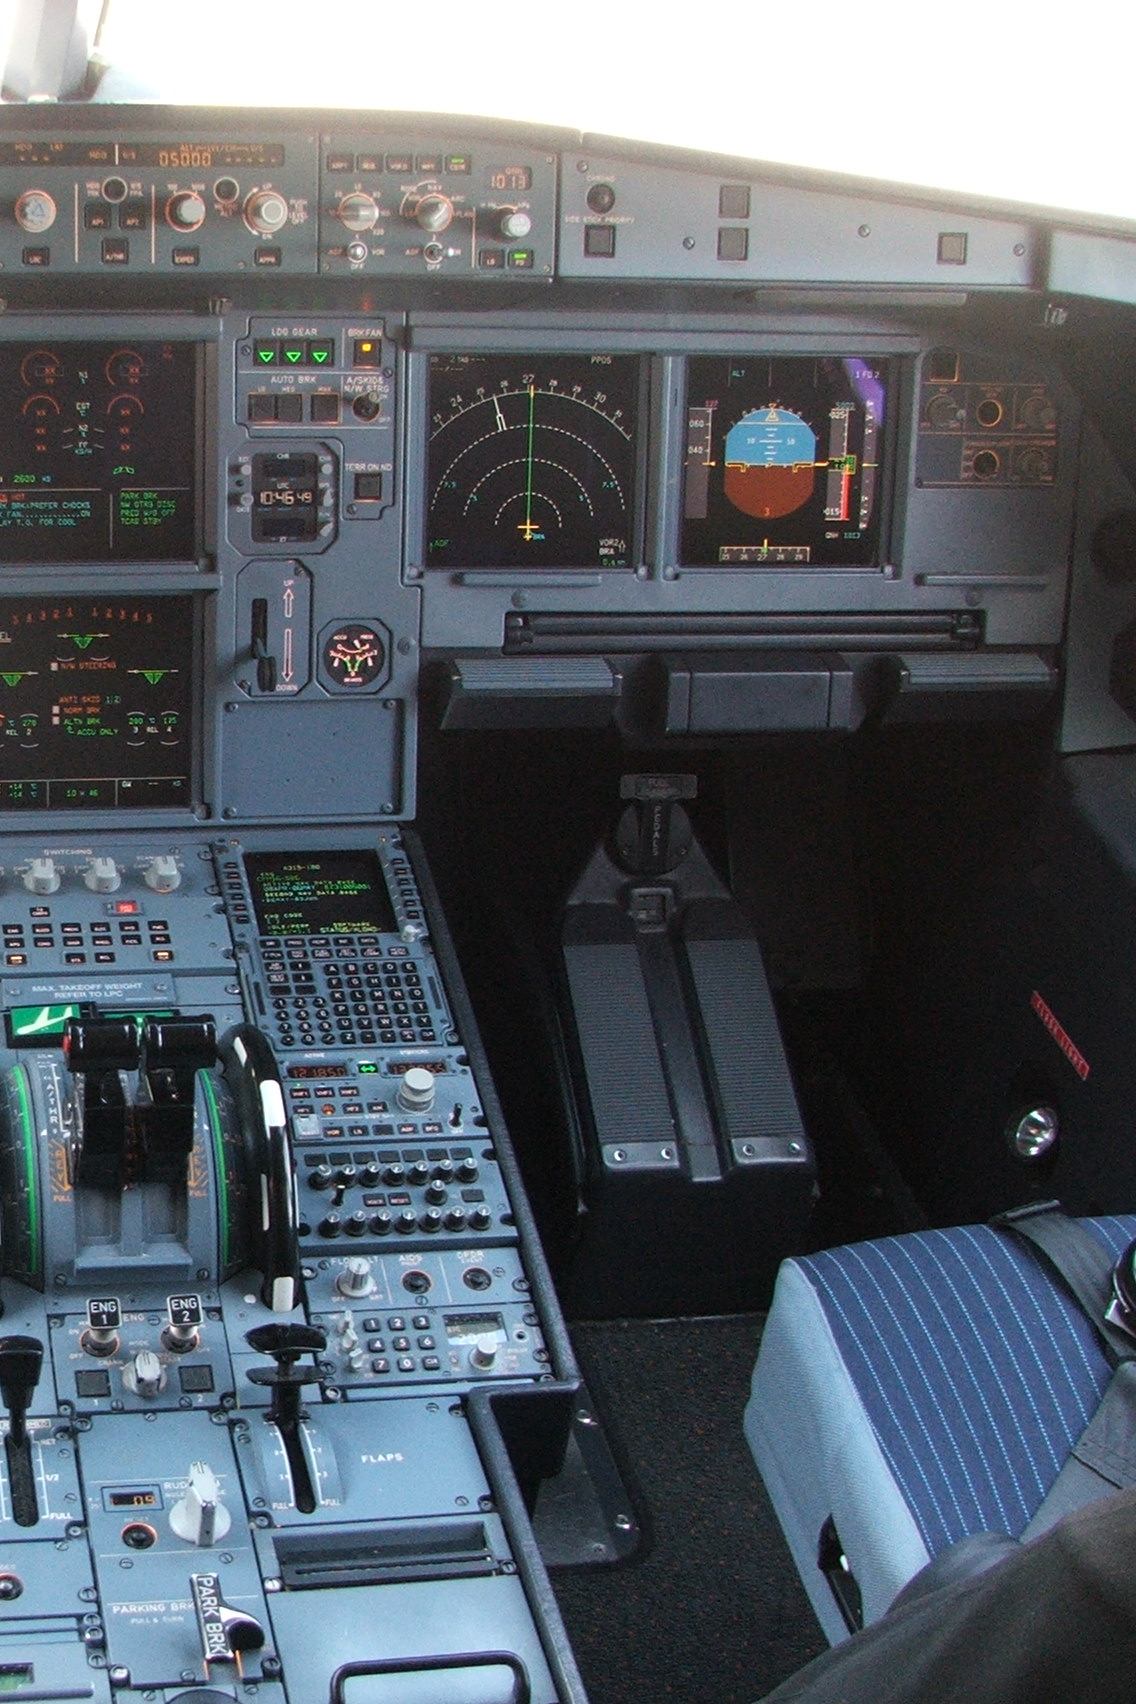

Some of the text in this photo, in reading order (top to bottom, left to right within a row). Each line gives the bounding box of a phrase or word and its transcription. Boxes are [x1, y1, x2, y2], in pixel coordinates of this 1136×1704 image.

[158, 151, 212, 167] 05000
[491, 176, 526, 190] 1013
[522, 374, 535, 384] 27
[592, 394, 607, 404] 30
[58, 983, 102, 992] TAKEOFF
[104, 982, 144, 990] WEIGHT
[54, 991, 82, 1000] REFER
[84, 990, 102, 998] TO
[90, 1301, 117, 1314] ENG
[171, 1298, 198, 1310] ENG
[102, 1314, 108, 1324] 1
[182, 1312, 190, 1322] 2
[361, 1452, 405, 1463] FLAPS
[164, 1481, 188, 1490] RUD
[112, 1602, 194, 1614] PARKING BRK
[198, 1574, 230, 1655] PARK BRK
